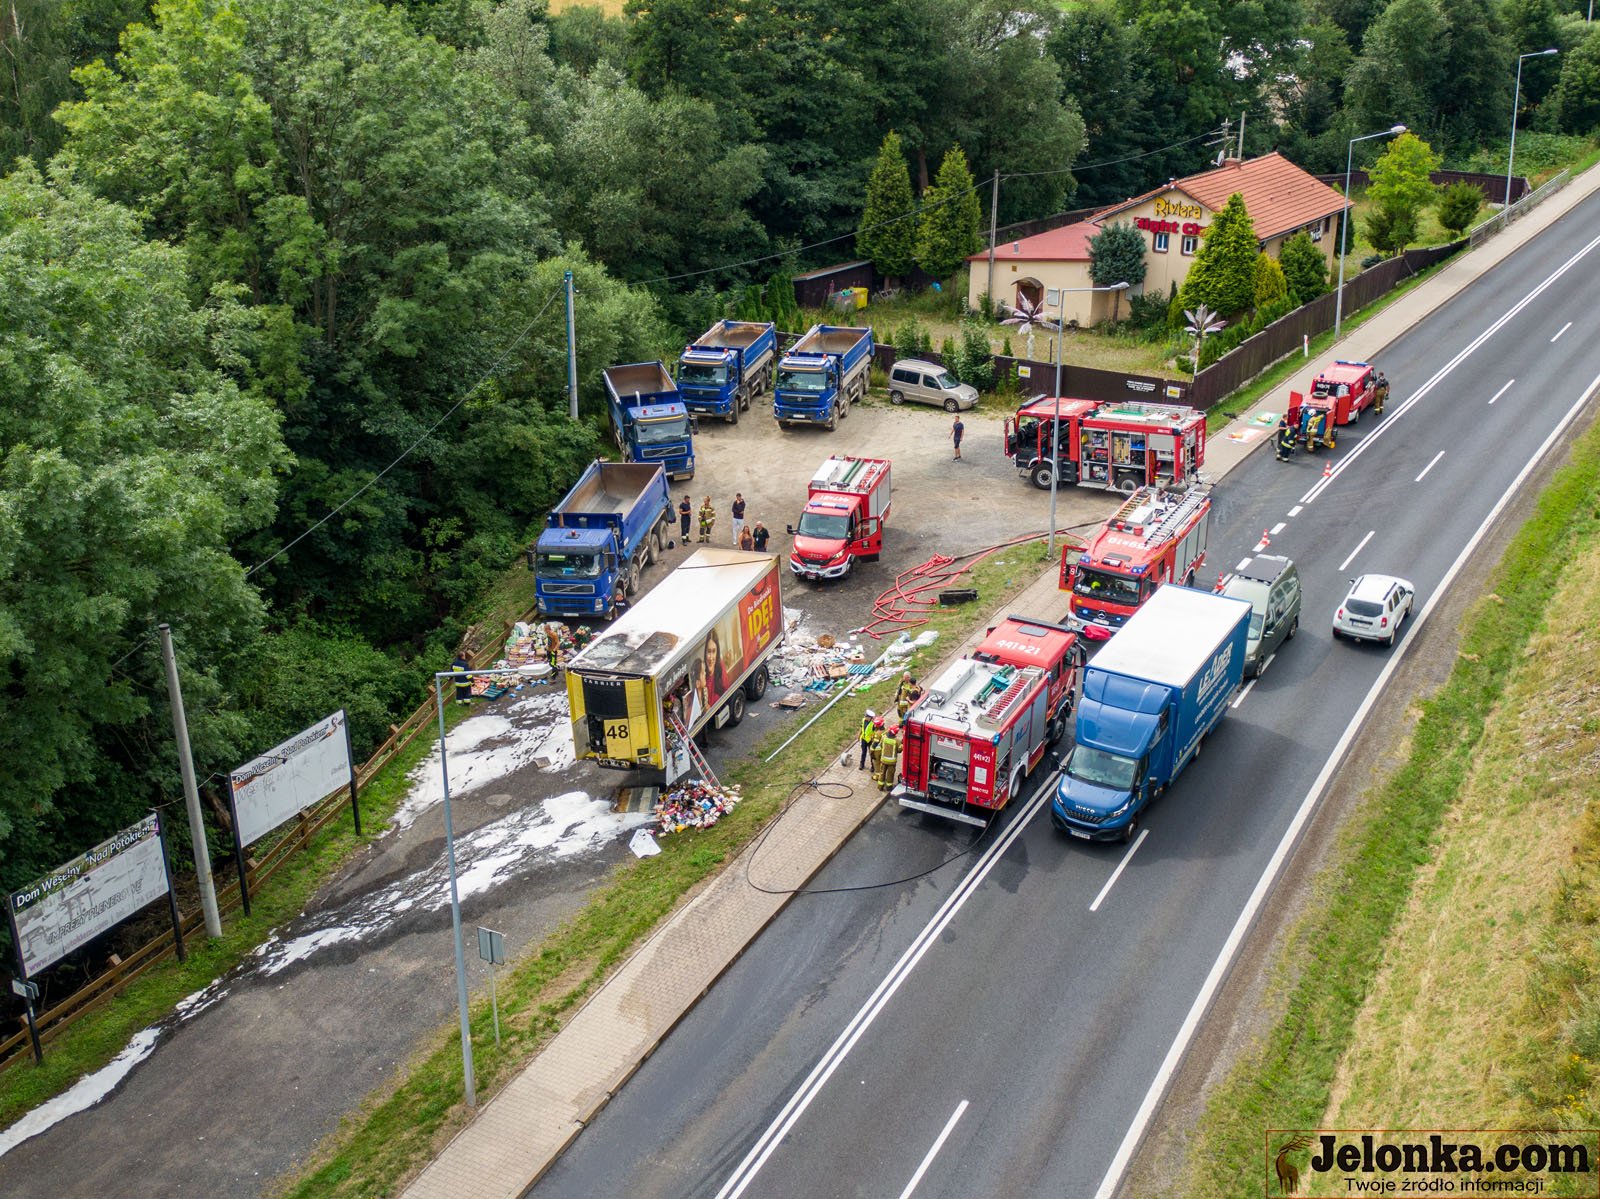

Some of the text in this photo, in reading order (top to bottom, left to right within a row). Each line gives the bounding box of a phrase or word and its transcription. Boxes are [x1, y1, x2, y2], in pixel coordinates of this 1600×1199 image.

[1154, 197, 1203, 219] Riviera
[583, 678, 621, 687] CARRIER
[606, 724, 629, 740] 48
[16, 888, 41, 908] Dom
[41, 864, 82, 893] Weselny
